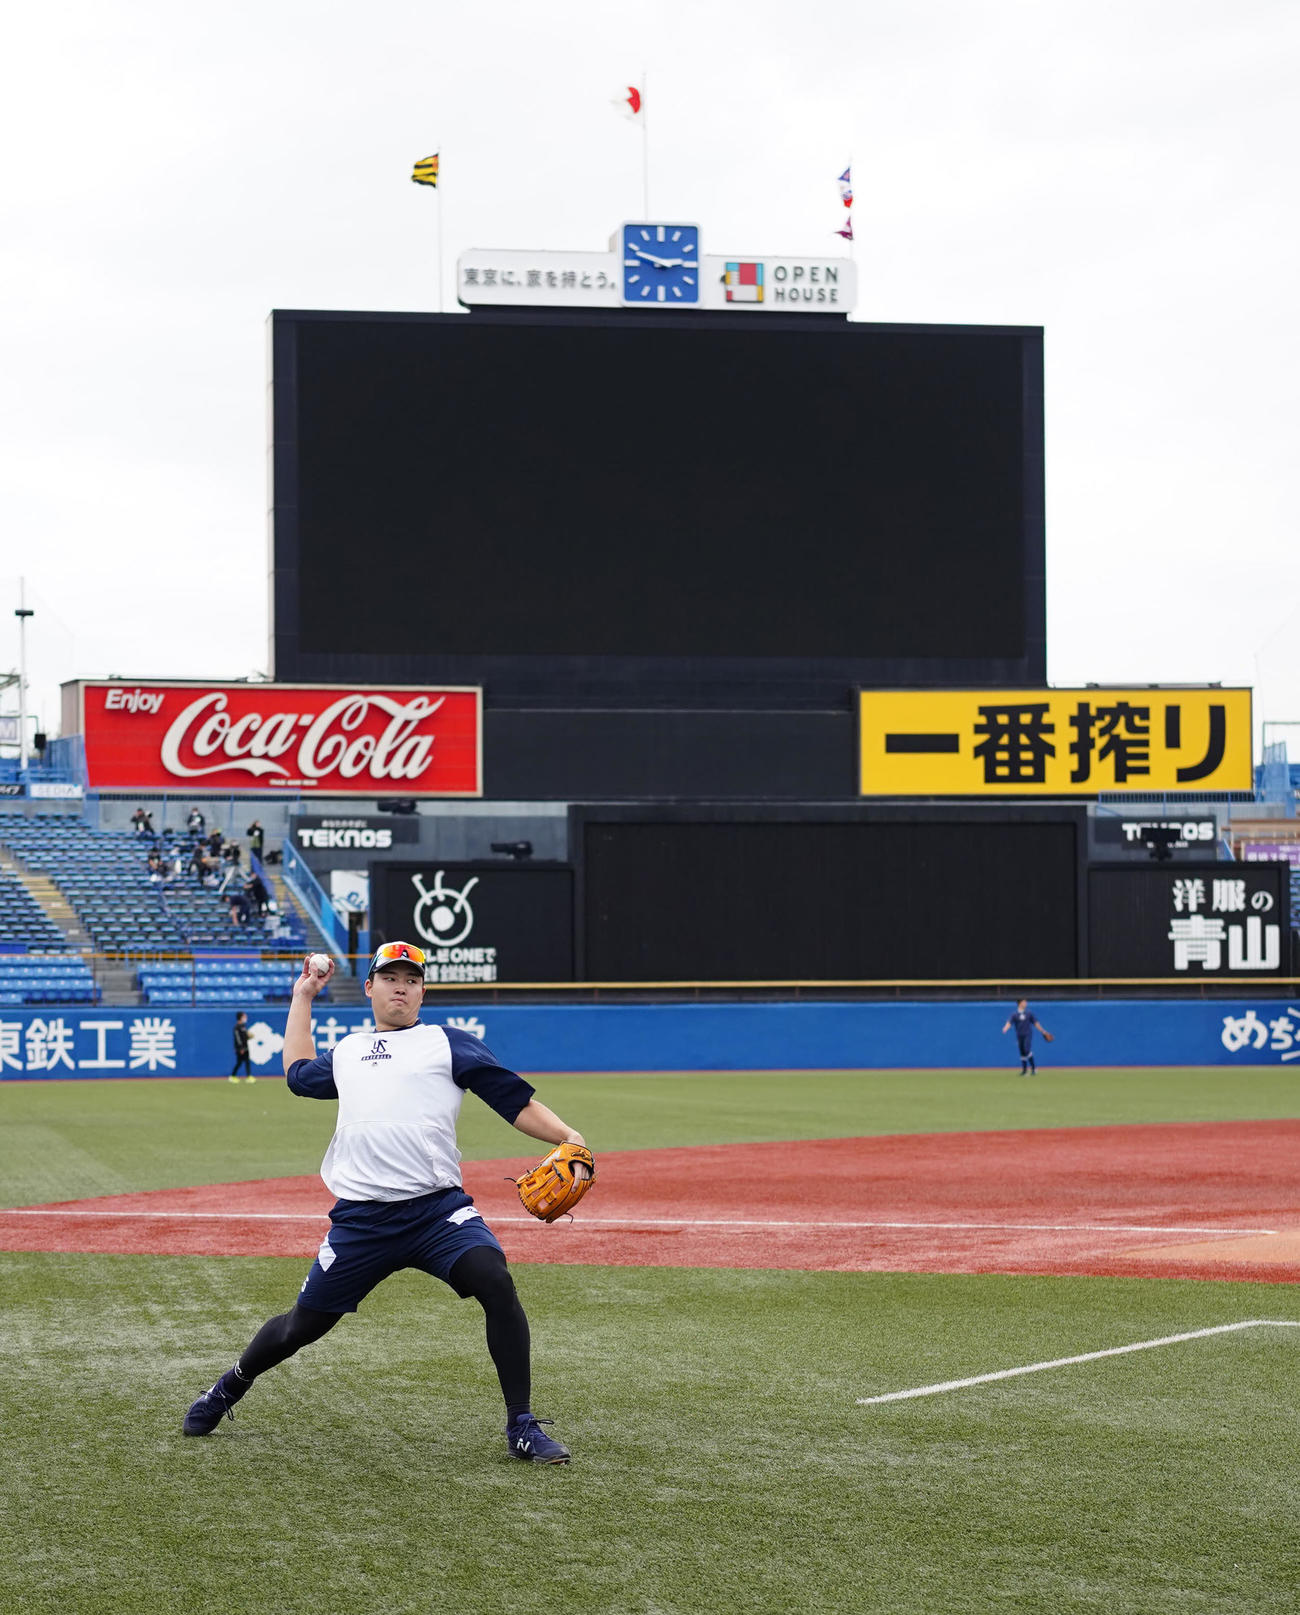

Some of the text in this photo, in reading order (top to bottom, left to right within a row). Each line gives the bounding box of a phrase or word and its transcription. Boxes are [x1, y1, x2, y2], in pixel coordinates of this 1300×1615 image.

[774, 265, 838, 283] OPEN
[775, 287, 839, 303] HOUSE
[105, 689, 164, 714] Enjoy
[160, 692, 446, 780] Coca-Cola
[885, 702, 1227, 784] 一番搾り
[297, 829, 392, 848] TEKNOS
[1172, 878, 1274, 912] 洋服の
[1168, 914, 1280, 970] 青山
[1221, 1010, 1300, 1053] めち
